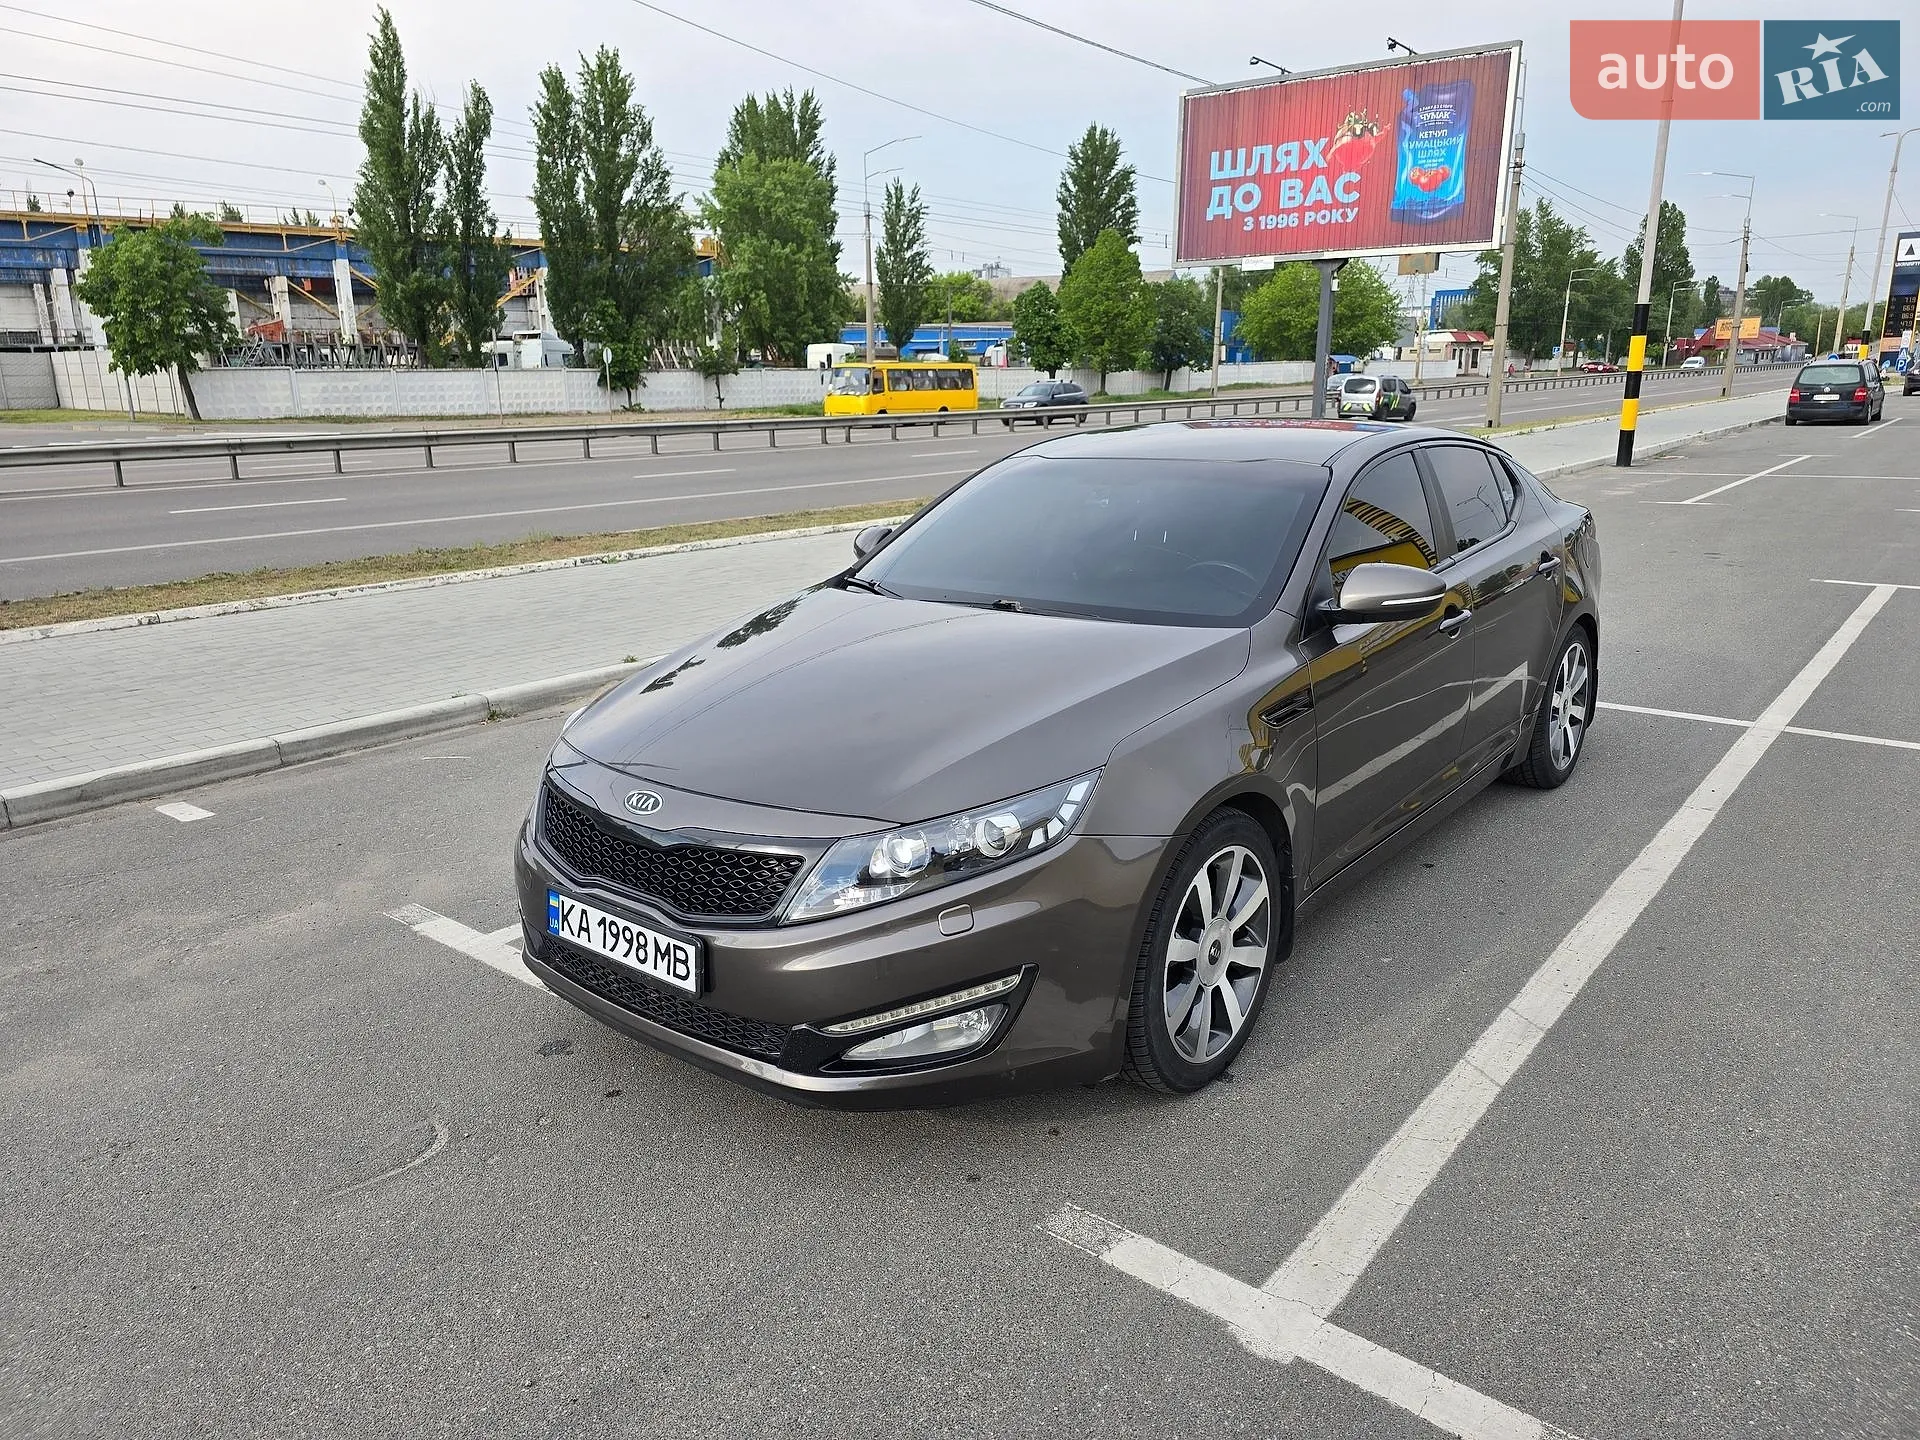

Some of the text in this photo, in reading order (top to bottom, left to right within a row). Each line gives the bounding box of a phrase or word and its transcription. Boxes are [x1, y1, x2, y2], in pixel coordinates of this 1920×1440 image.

[1420, 112, 1450, 120] ЧУМАК
[1419, 129, 1447, 138] КЕТЧУП
[1210, 137, 1329, 180] ШЛЯХ
[1418, 148, 1447, 158] ШЛЯХ
[1206, 172, 1361, 221] ДО ВАС
[1259, 213, 1299, 230] 1996
[1304, 207, 1359, 226] РОКУ
[628, 793, 656, 810] KIA
[549, 917, 559, 929] UA
[561, 900, 690, 981] KA 1998 MB
